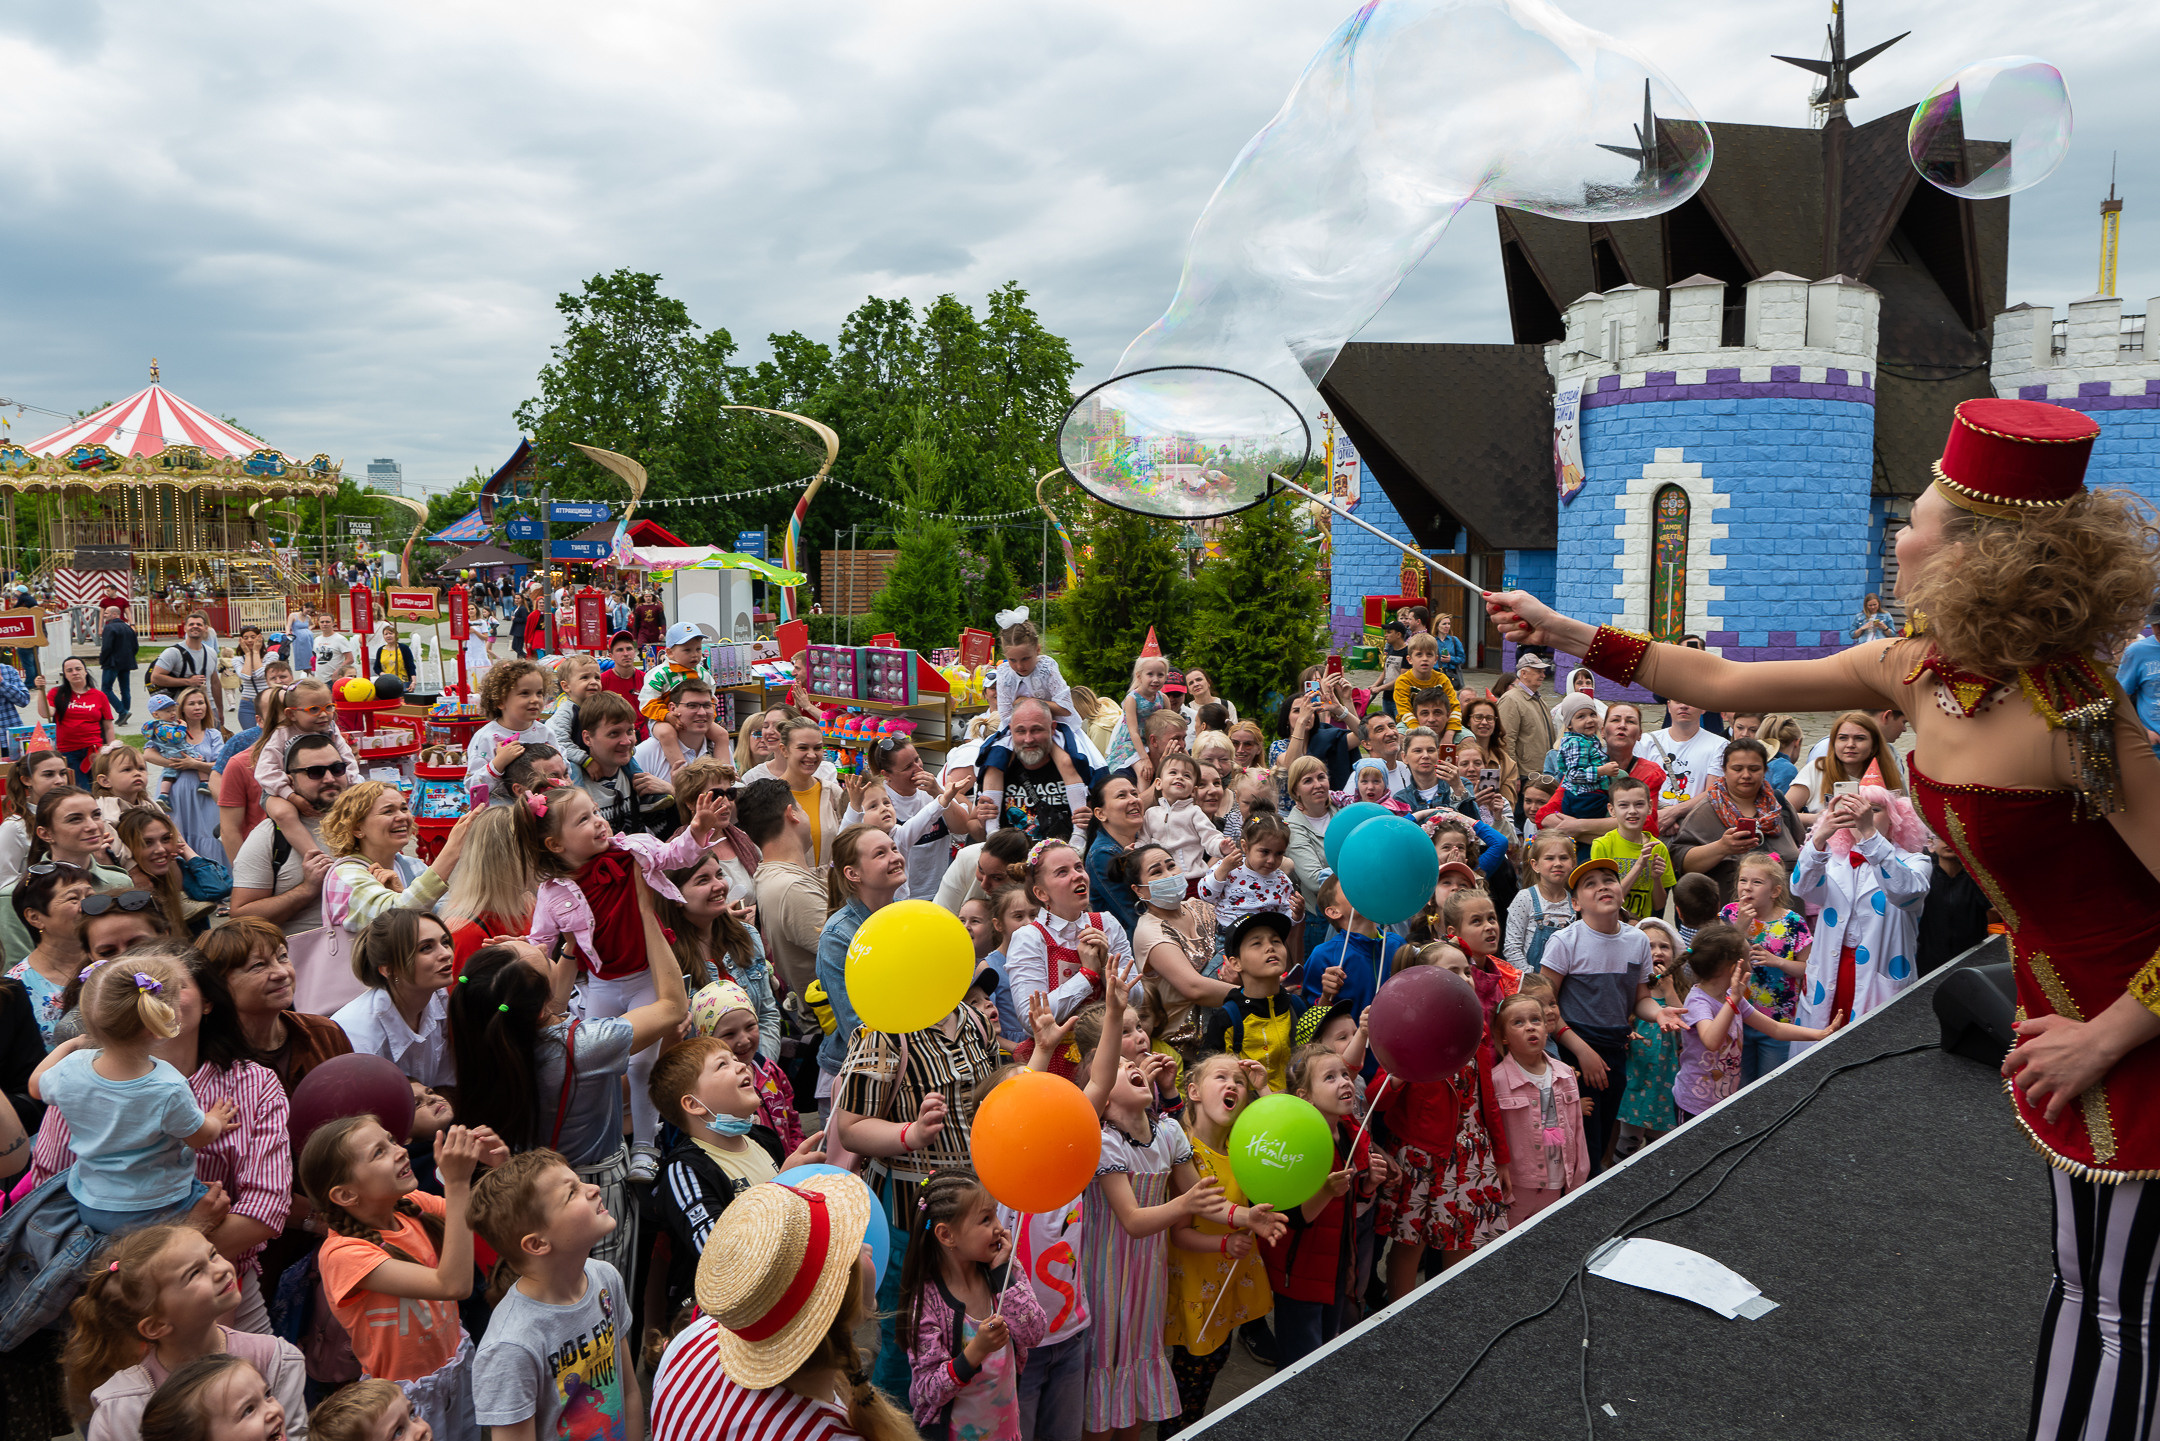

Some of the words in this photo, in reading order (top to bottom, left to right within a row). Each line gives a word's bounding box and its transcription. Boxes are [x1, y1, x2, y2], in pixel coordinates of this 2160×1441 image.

[1659, 533, 1685, 541] КВЕСТОВ
[1005, 781, 1066, 796] SAAGE
[1005, 795, 1069, 807] STOIES
[1245, 1131, 1304, 1172] Hamleys
[547, 1333, 590, 1378] RIDE
